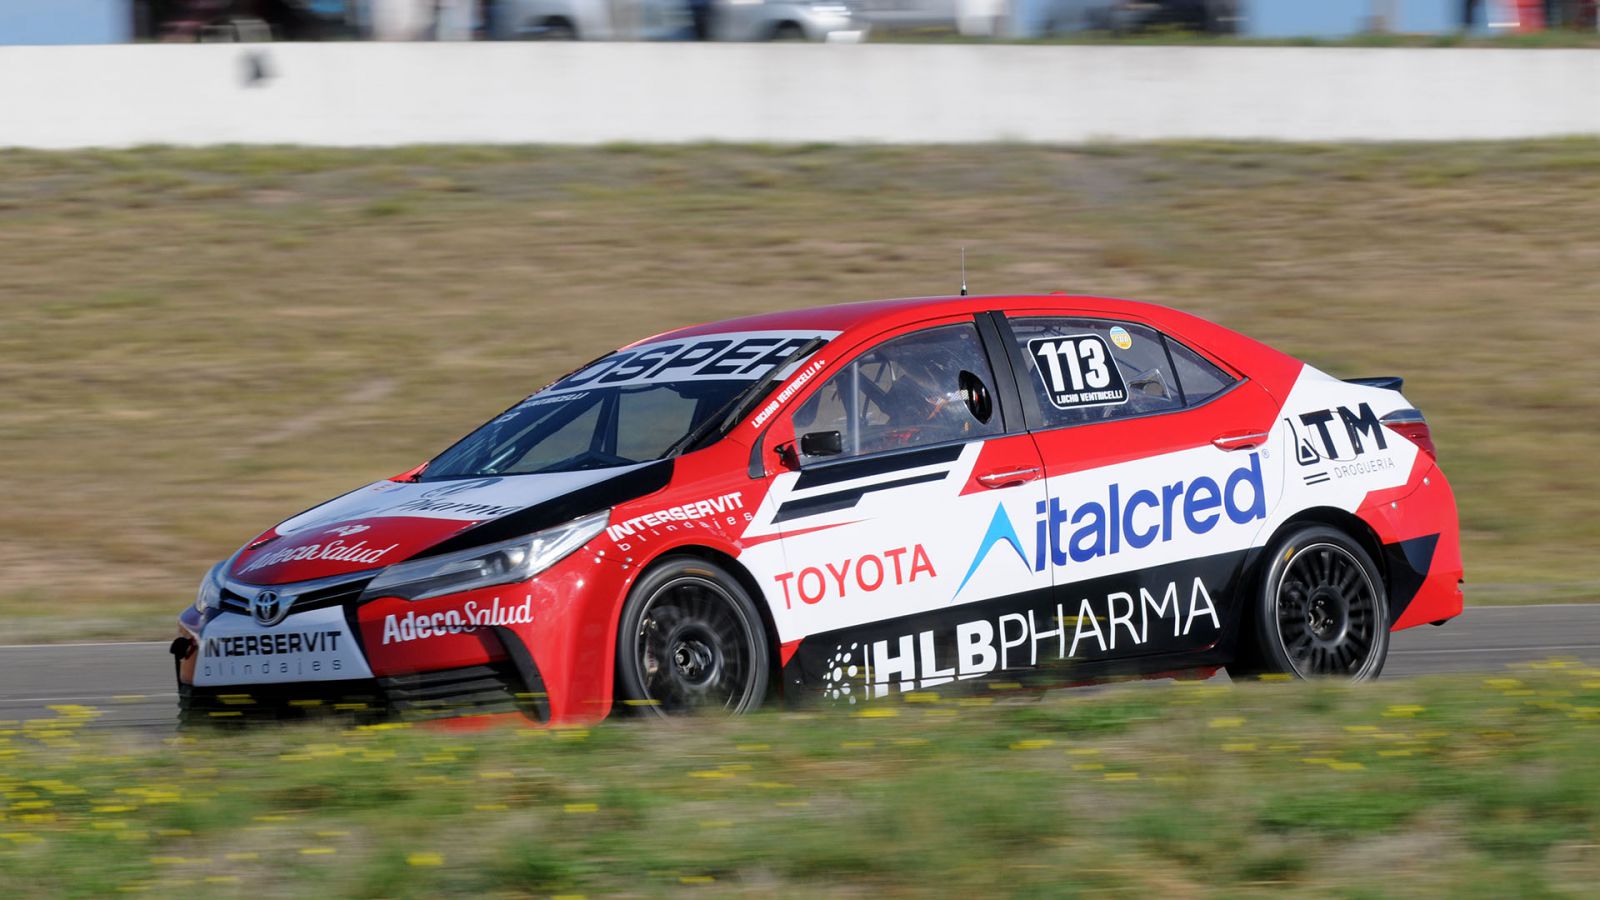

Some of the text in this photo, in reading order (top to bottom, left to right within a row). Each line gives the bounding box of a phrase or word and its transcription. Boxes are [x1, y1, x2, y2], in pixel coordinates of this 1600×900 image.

[1037, 339, 1111, 392] 113
[751, 401, 780, 428] LUCIANO
[776, 366, 816, 404] VENTRICELLI
[1056, 390, 1123, 404] LUCHO VENTRICELLI
[1333, 458, 1395, 479] DROGUERIA
[606, 491, 744, 542] INTERSERVIT
[617, 512, 753, 552] blindajes
[1034, 452, 1266, 572] italcred
[774, 543, 937, 610] TOYOTA
[204, 631, 342, 658] INTERSERVIT
[382, 594, 534, 645] AdecoSalud
[204, 658, 343, 677] blindajes
